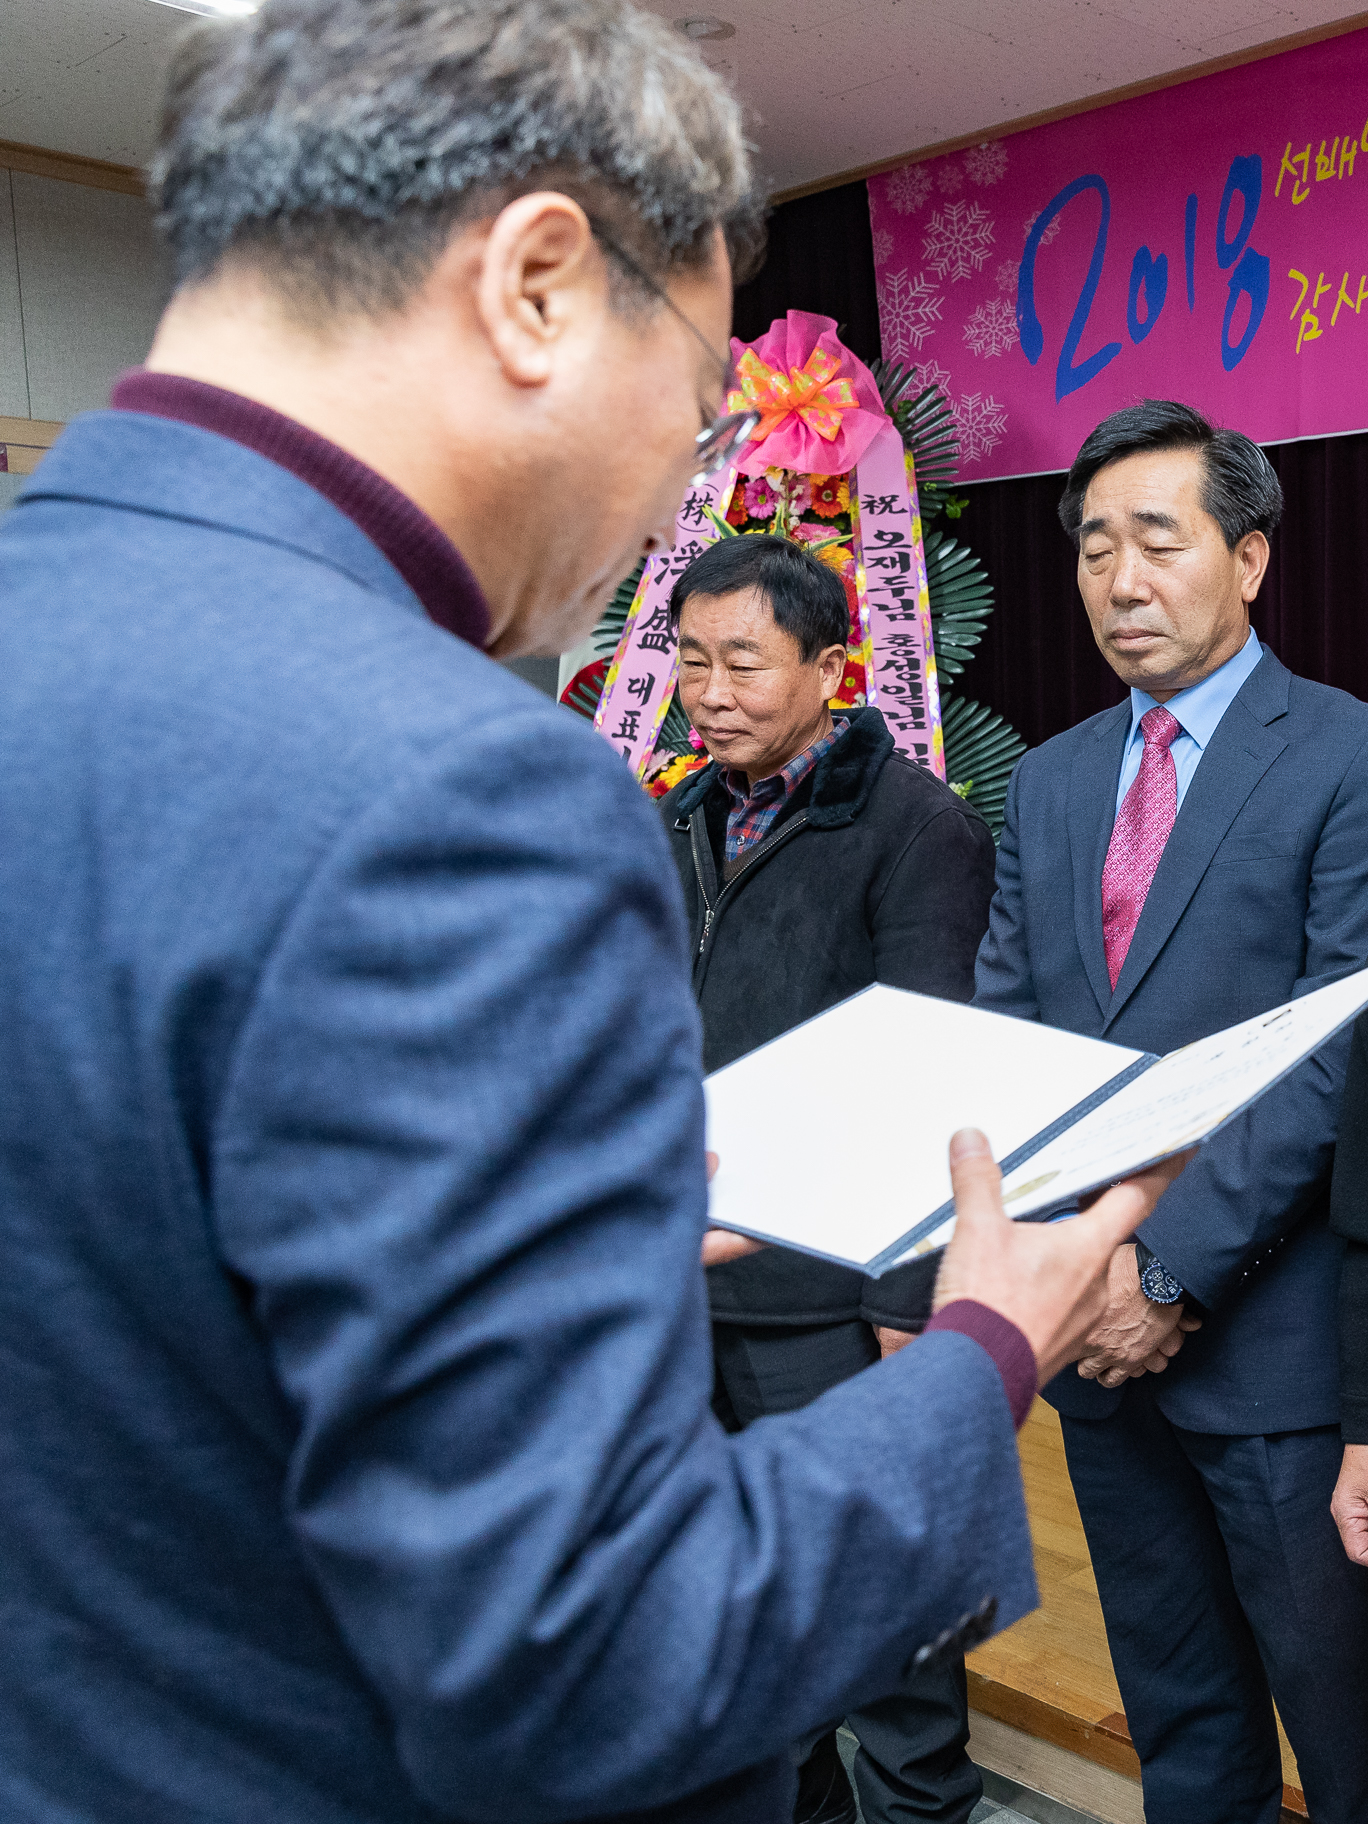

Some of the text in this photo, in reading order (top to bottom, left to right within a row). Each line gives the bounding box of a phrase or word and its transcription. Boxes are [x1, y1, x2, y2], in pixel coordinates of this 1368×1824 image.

[1015, 153, 1271, 404] 2018
[860, 493, 909, 516] 祝
[862, 529, 918, 622] 오재두님
